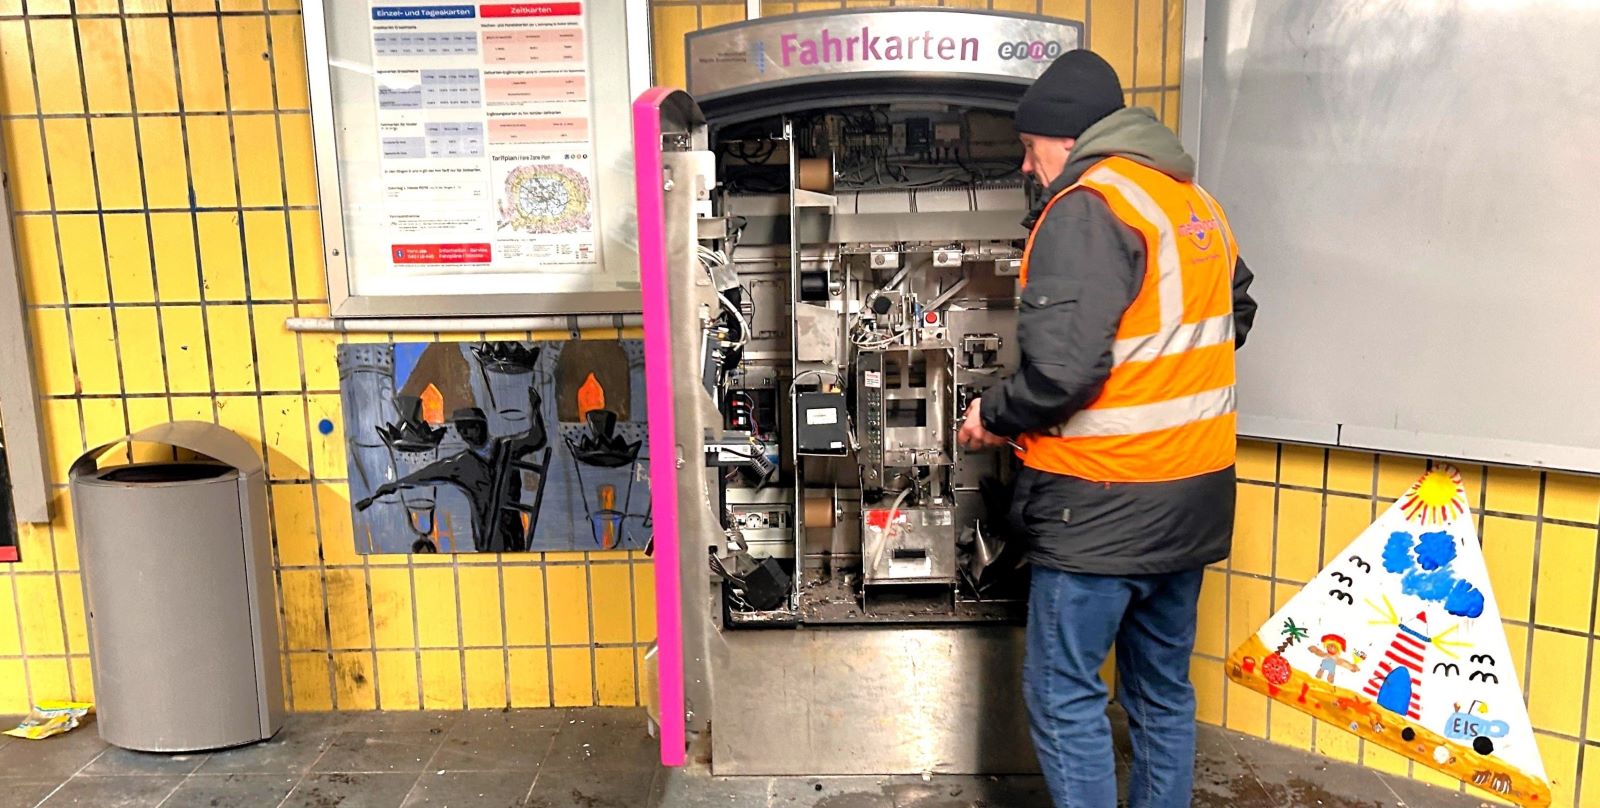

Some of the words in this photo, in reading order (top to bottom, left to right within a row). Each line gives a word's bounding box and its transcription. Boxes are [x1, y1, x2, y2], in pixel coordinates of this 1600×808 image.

[377, 9, 403, 17] Einzel-
[421, 8, 471, 17] Tageskarten
[780, 26, 979, 67] Fahrkarten
[999, 41, 1060, 60] enno
[1453, 717, 1479, 737] EIS
